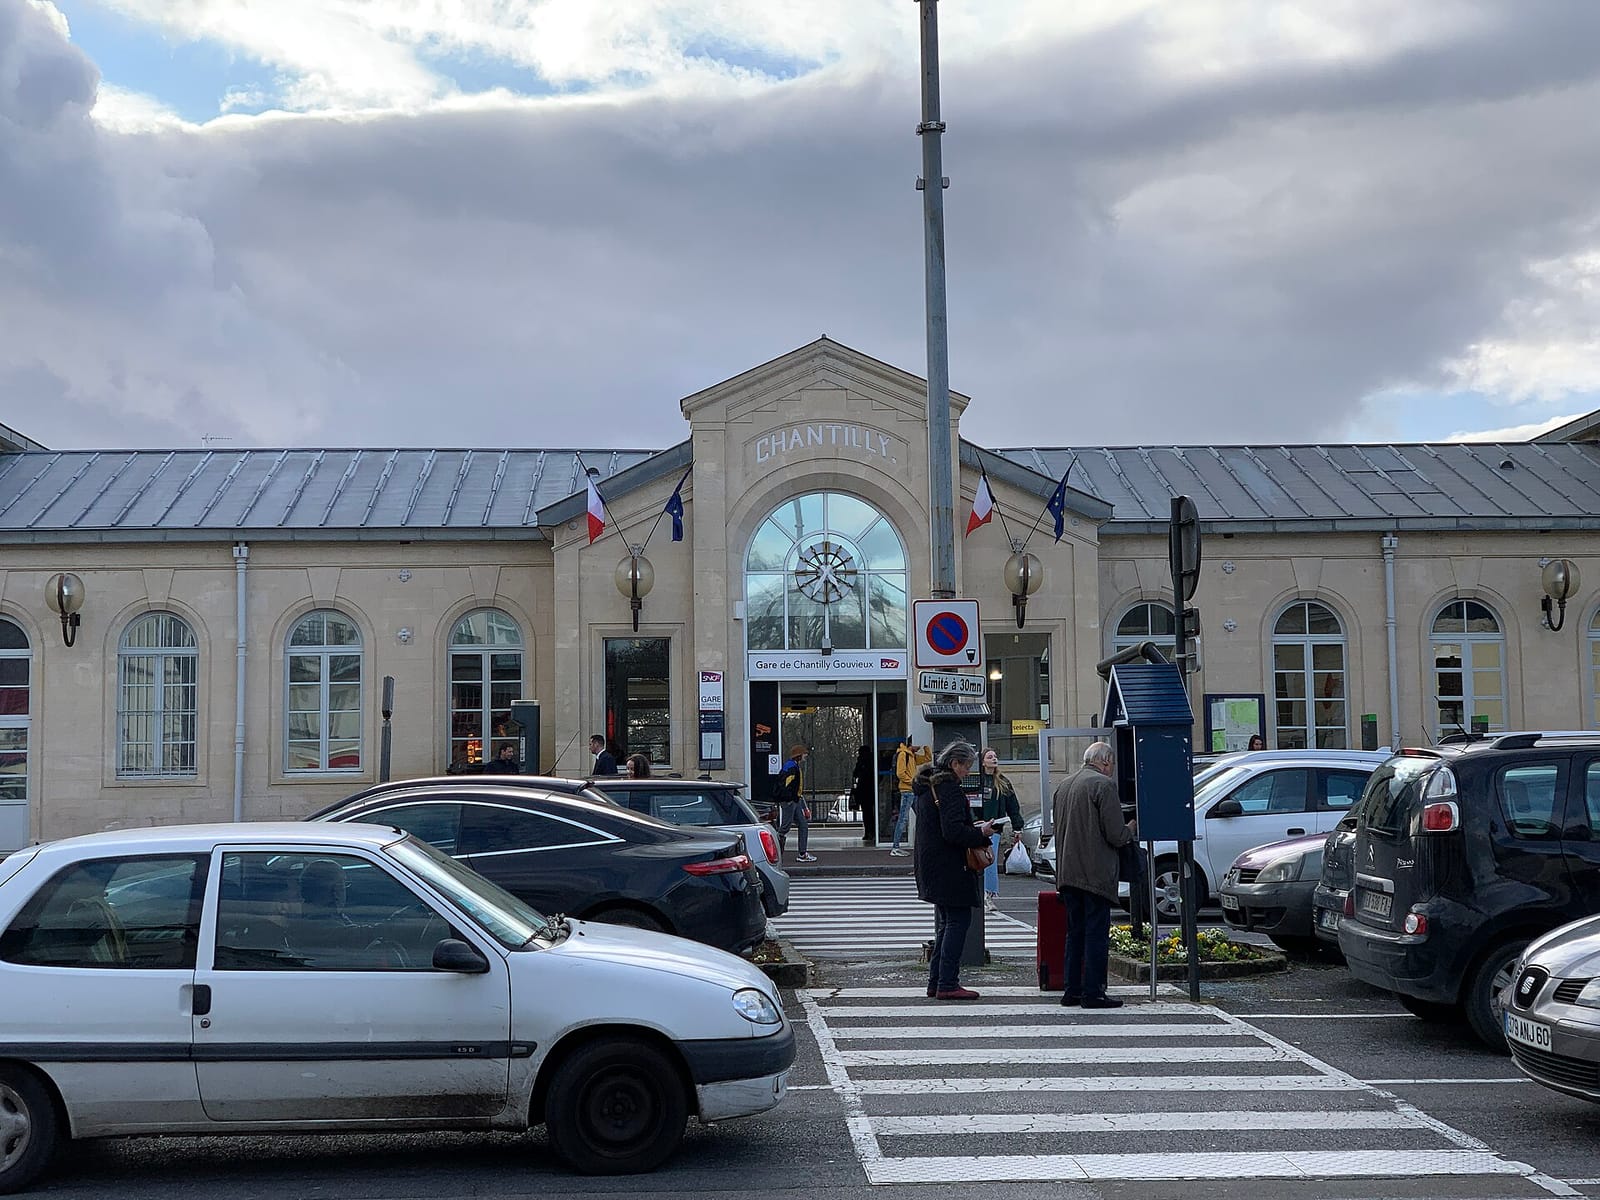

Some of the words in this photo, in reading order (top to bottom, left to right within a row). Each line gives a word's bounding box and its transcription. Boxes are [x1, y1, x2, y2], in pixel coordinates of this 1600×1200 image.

[755, 660, 777, 670] Gare
[780, 660, 791, 669] de
[793, 659, 831, 671] Chantilly
[833, 659, 874, 669] Gouvieux
[923, 675, 949, 690] Limité
[951, 678, 957, 691] à
[959, 678, 982, 692] 30mn
[701, 695, 721, 703] GARE
[1520, 1021, 1535, 1042] ANJ
[1536, 1026, 1550, 1047] 60
